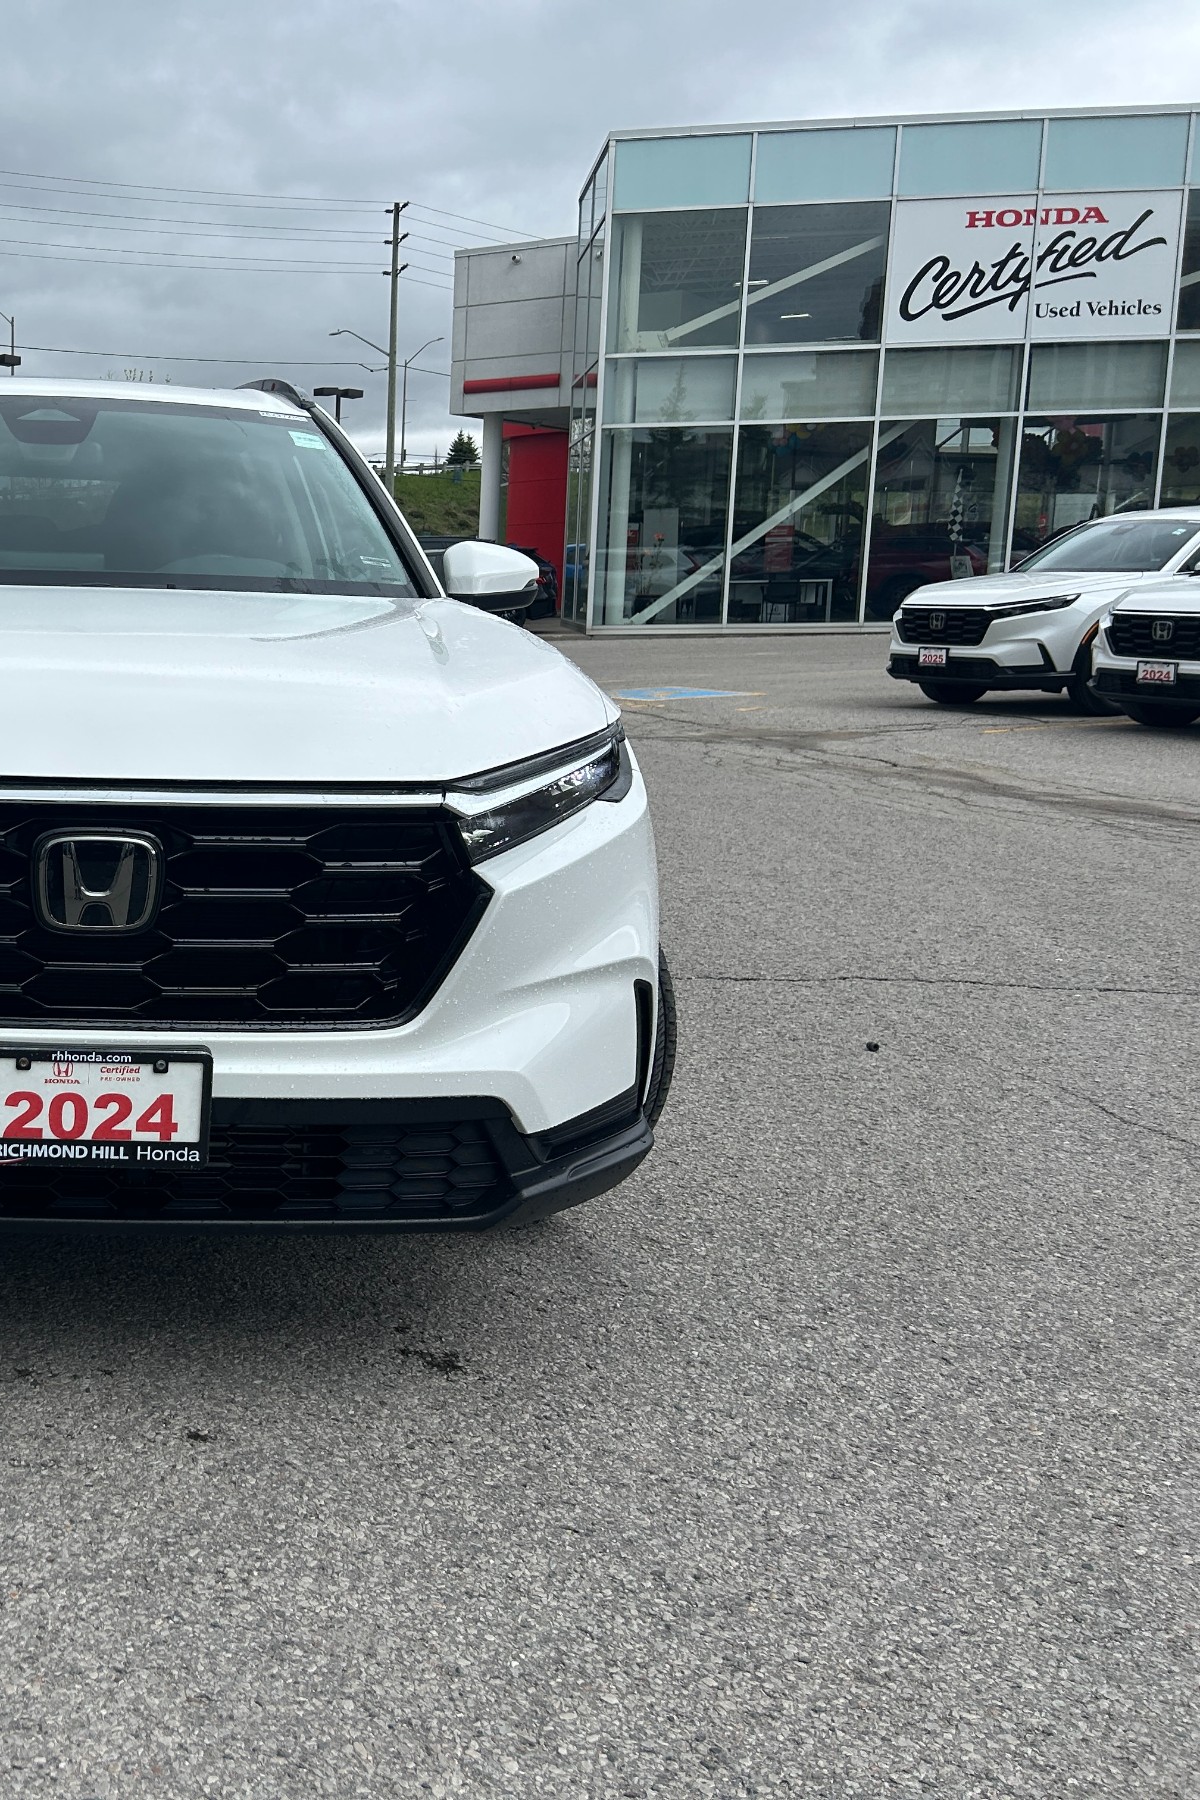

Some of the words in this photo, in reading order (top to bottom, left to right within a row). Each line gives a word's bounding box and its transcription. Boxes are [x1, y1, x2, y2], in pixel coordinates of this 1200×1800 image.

[965, 206, 1109, 229] HONDA
[899, 208, 1167, 322] Certified
[1035, 302, 1081, 319] Used
[1087, 299, 1162, 318] Vehicles
[922, 653, 944, 664] 2025
[1142, 670, 1171, 681] 2024
[51, 1050, 132, 1063] rhhonda.com
[100, 1065, 141, 1076] Certified
[2, 1090, 179, 1141] 2024
[91, 1146, 129, 1160] HILL
[136, 1145, 200, 1163] Honda
